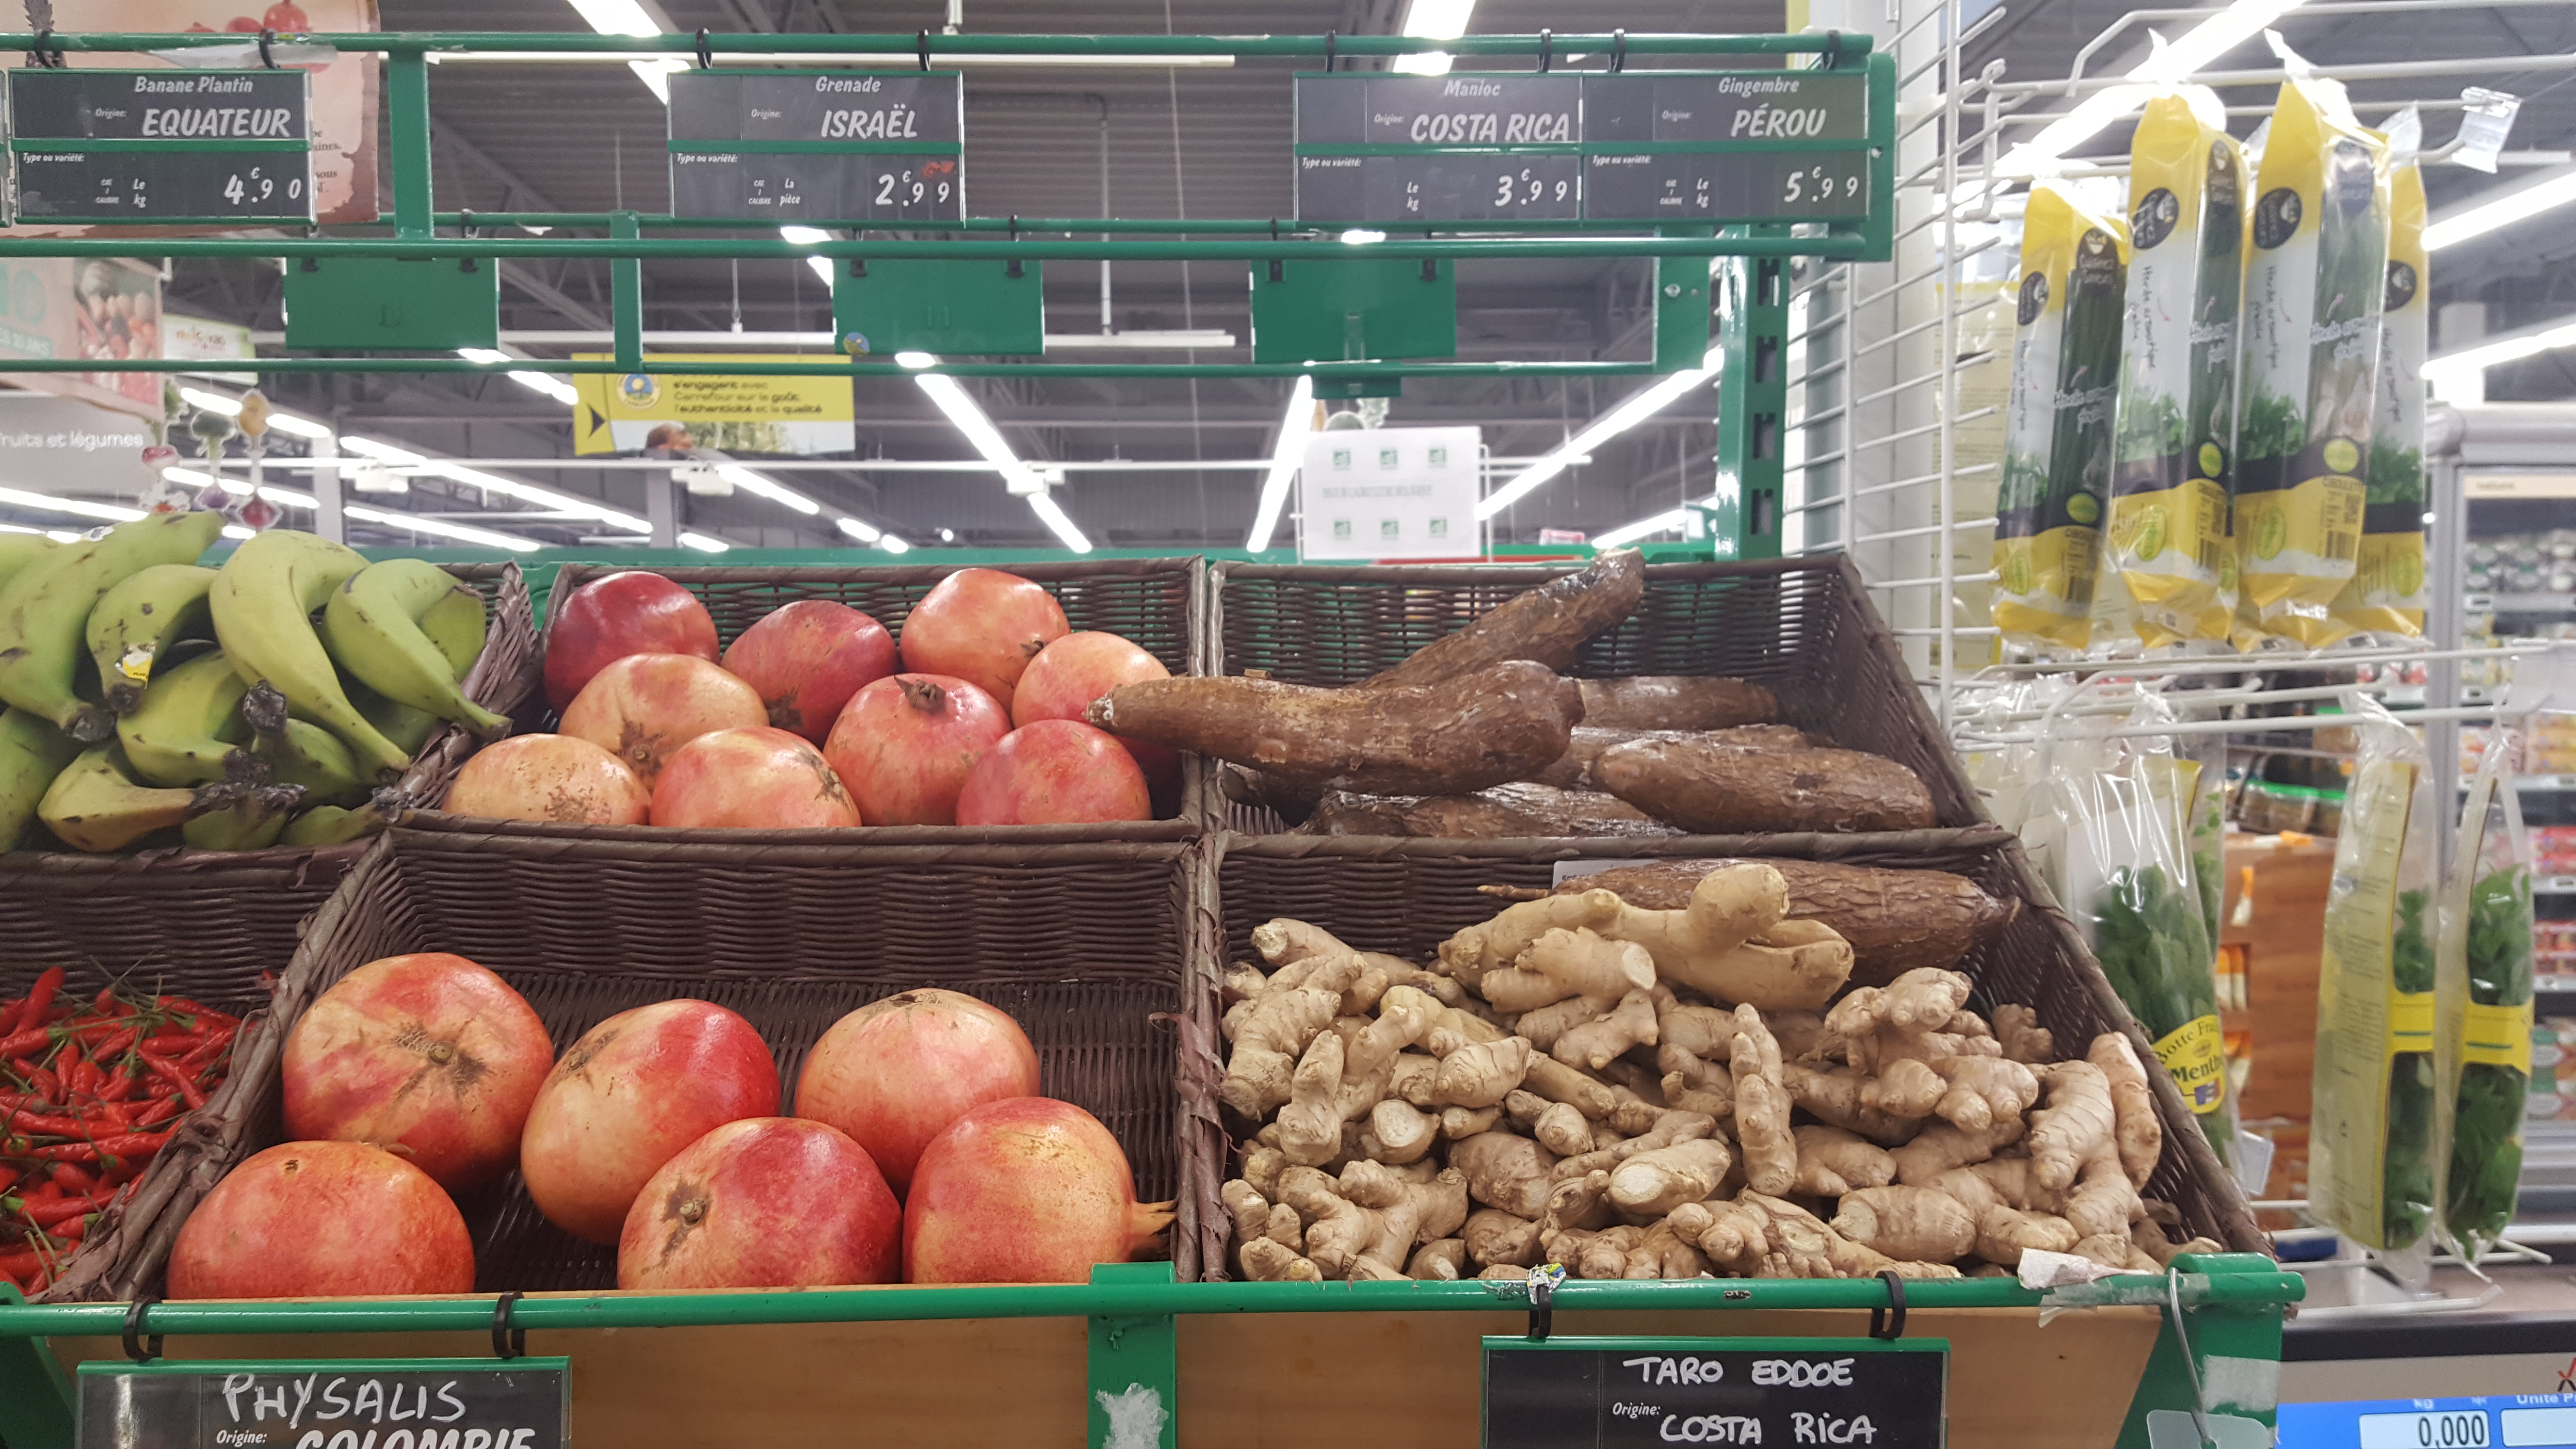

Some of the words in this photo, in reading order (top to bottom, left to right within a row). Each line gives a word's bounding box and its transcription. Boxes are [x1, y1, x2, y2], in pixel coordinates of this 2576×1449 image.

[134, 76, 194, 93] Banane
[197, 76, 254, 93] Plantin
[815, 76, 881, 93] Grenade
[1443, 79, 1500, 97] Manioc
[1718, 76, 1800, 98] Gingembre
[142, 108, 291, 137] EQUATEUR
[751, 108, 782, 120] Origine:
[821, 103, 917, 139] ISRAËL
[1730, 103, 1827, 138] PÉROU
[1411, 113, 1497, 143] COSTA
[1504, 113, 1569, 142] RICA
[23, 152, 41, 164] Type
[677, 153, 695, 164] Type
[708, 154, 739, 163] variété:
[1302, 157, 1320, 168] Type
[1593, 154, 1610, 166] Type
[132, 178, 145, 190] Le
[784, 177, 795, 189] La
[1407, 181, 1419, 194] Le
[1696, 177, 1709, 191] Le
[133, 193, 146, 209] kg
[779, 193, 801, 207] pièce
[1407, 196, 1419, 212] kg
[1696, 193, 1709, 209] kg
[674, 391, 735, 402] Carrefour
[0, 432, 44, 448] ruits
[46, 433, 67, 448] et
[70, 429, 144, 452] légumes
[1623, 1356, 1724, 1385] TARO
[1751, 1357, 1855, 1388] EDDOE
[222, 1372, 467, 1429] PHYSALIS
[1612, 1401, 1661, 1419] Origine:
[216, 1429, 268, 1447] Origine:
[1659, 1414, 1762, 1446] COSTA
[2418, 1415, 2485, 1449] 0,000
